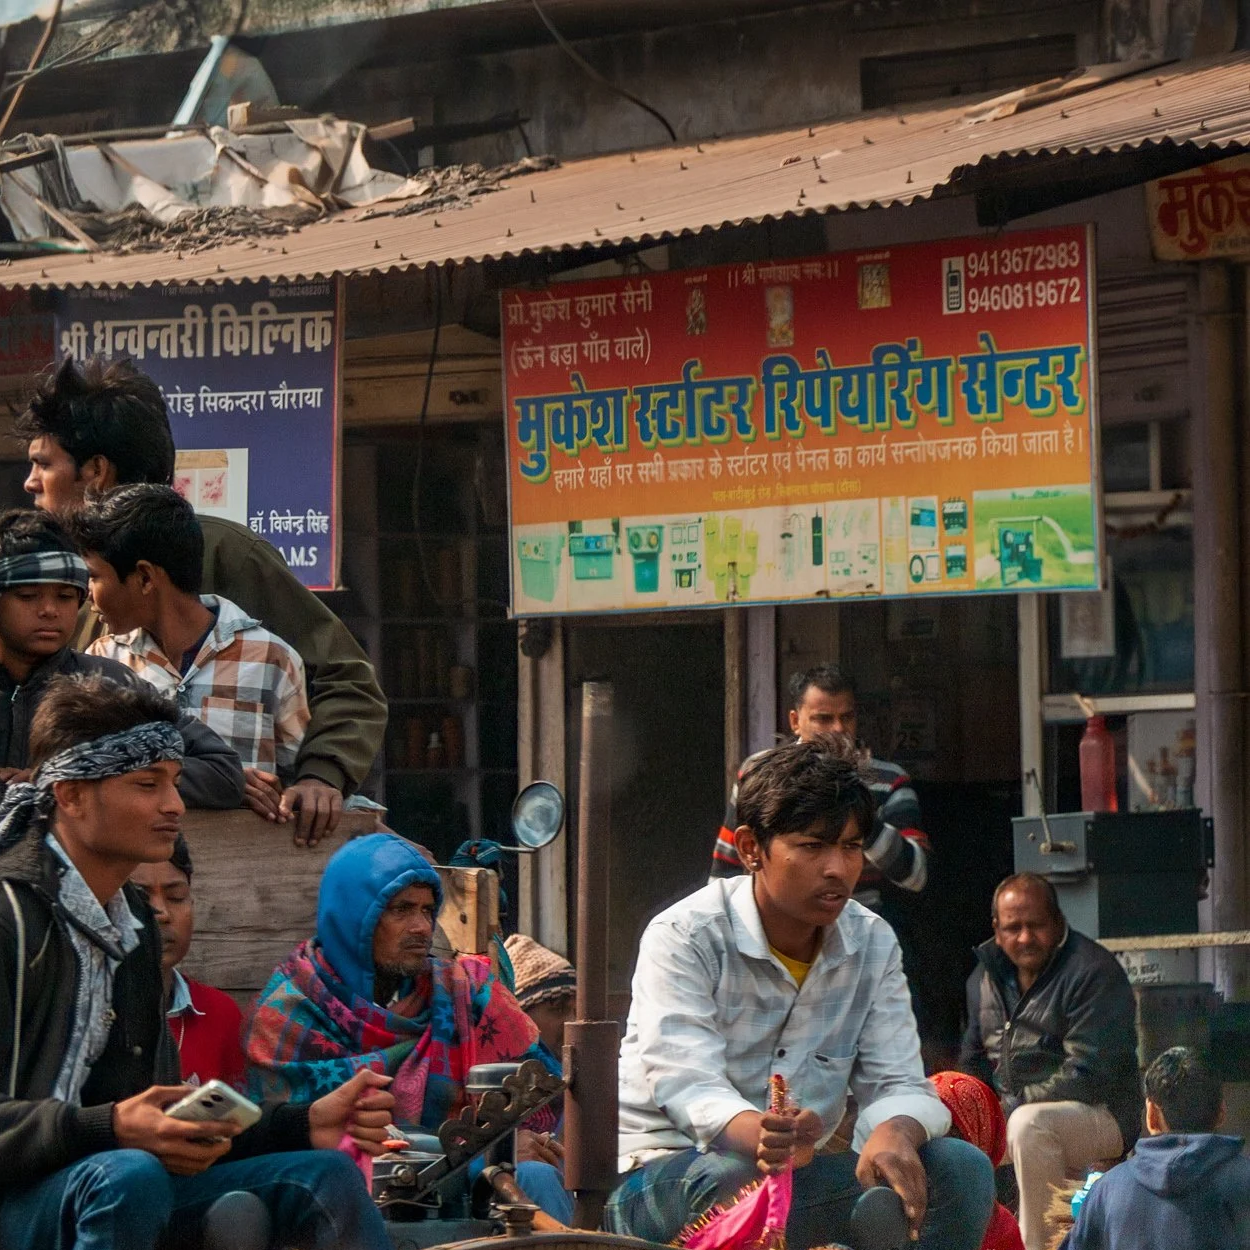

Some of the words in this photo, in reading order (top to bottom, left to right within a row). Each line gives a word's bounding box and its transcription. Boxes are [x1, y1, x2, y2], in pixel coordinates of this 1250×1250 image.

[968, 241, 1080, 278] 9413672983
[575, 292, 617, 329] कुमार
[620, 280, 652, 314] सैनी
[968, 276, 1081, 313] 9460819672
[549, 342, 578, 370] बड़ा
[581, 331, 610, 364] गाँव
[614, 327, 651, 365] वाले)
[166, 385, 195, 419] रोड़
[199, 385, 266, 415] सिकन्दरा
[269, 381, 323, 410] चौराया
[514, 371, 631, 484] मुकेश
[957, 331, 1086, 423] सेन्टर
[554, 461, 585, 493] हमारे
[589, 456, 612, 488] यहाँ
[616, 465, 633, 485] पर
[637, 452, 664, 483] सभी
[707, 449, 723, 480] के
[772, 443, 791, 477] एवं
[795, 442, 830, 474] पैनल
[834, 446, 852, 470] का
[856, 434, 887, 467] कार्य
[891, 432, 977, 465] सन्तोषजनक
[980, 426, 1018, 458] किया
[1021, 429, 1059, 457] जाता
[249, 510, 266, 534] डॉ.
[269, 509, 305, 536] विजेन्द्र
[306, 508, 330, 534] सिंह
